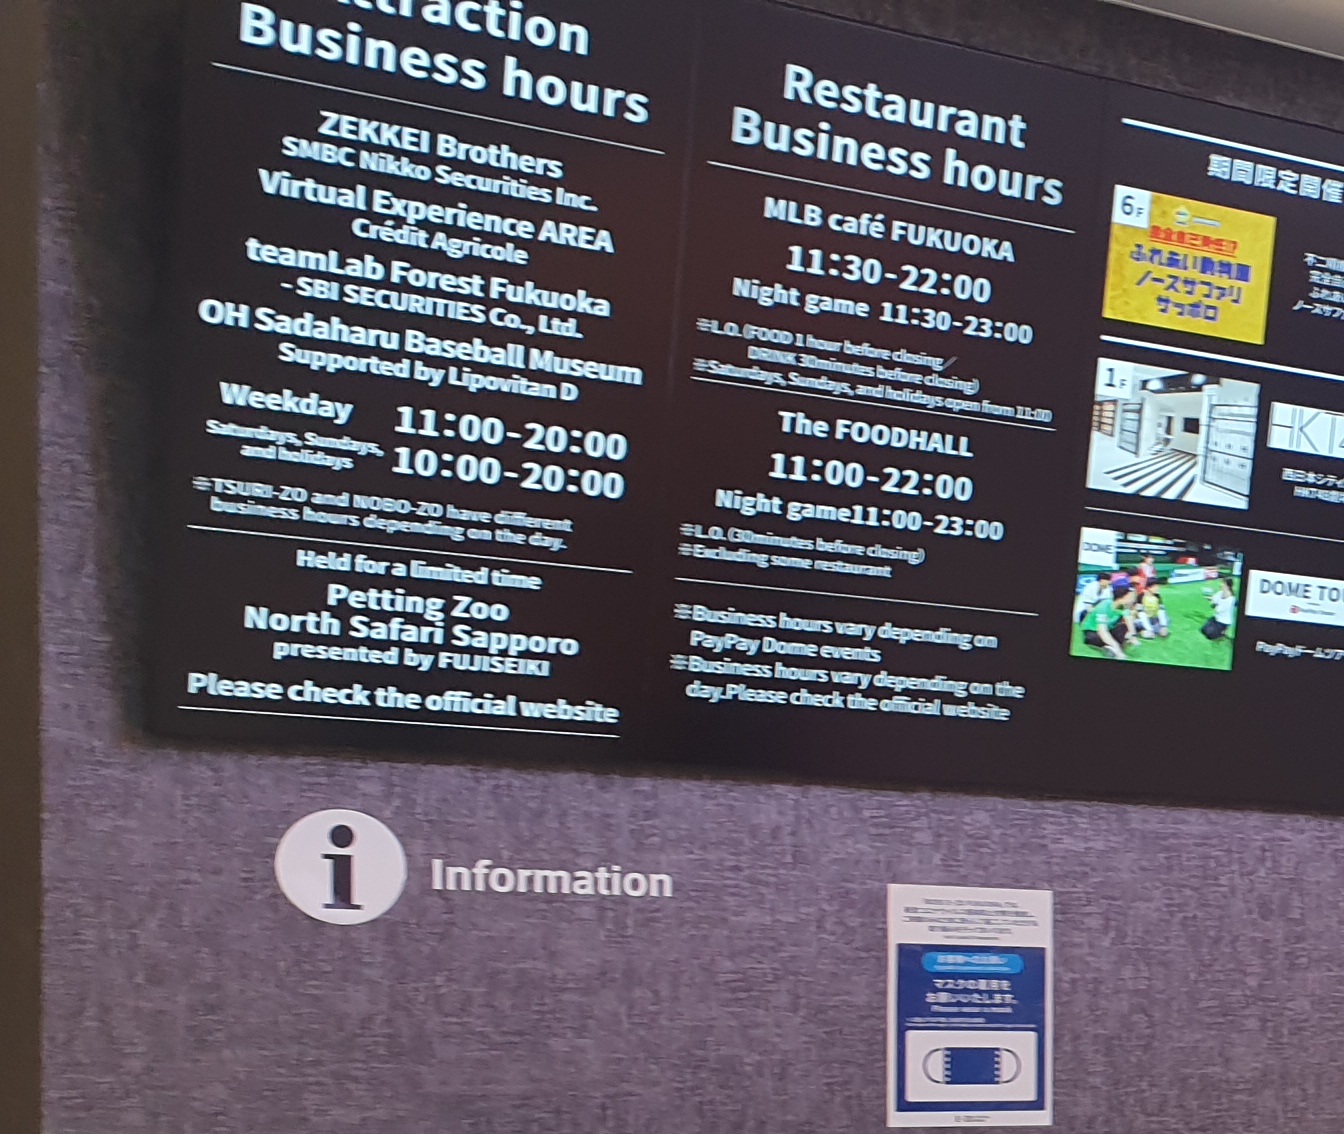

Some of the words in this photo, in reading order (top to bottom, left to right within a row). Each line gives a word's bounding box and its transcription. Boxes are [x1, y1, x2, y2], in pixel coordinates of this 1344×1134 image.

[337, 0, 589, 56] raction
[239, 2, 487, 91] Business
[502, 56, 650, 124] hours
[783, 63, 1026, 149] Restaurant
[318, 110, 429, 153] ZEKKEI
[437, 133, 563, 178] Brothers
[731, 105, 932, 180] Business
[943, 149, 1065, 206] hours
[281, 136, 354, 167] SMBC
[359, 153, 431, 180] Nikko
[435, 165, 552, 204] Securities
[556, 188, 599, 211] Inc.
[1207, 153, 1344, 204] 期間限定開催
[258, 169, 366, 211] Virtual
[373, 189, 533, 241] Experience
[539, 217, 614, 253] AREA
[763, 196, 823, 227] MLB
[828, 210, 885, 238] café
[890, 220, 1015, 263] FUKUOKA
[352, 218, 428, 251] Crédit
[431, 231, 528, 264] Agricole
[245, 238, 384, 281] teamLab
[392, 261, 483, 297] Forest
[490, 277, 611, 317] Fukuoka
[785, 245, 991, 303] 11:30-22:00
[296, 278, 338, 301] SBI
[343, 284, 485, 323] SECURITIES
[539, 315, 583, 339] Ltd.
[732, 277, 800, 307] Night
[805, 294, 870, 317] game
[879, 302, 1033, 344] 11:30-23:00
[199, 300, 250, 327] OH
[254, 306, 399, 349] Sadaharu
[406, 330, 525, 369] Baseball
[529, 348, 643, 385] Museum
[279, 343, 410, 380] Supported
[414, 361, 444, 387] by
[449, 367, 556, 400] Lipovitan
[560, 382, 579, 401] D
[206, 419, 302, 448] Saturdays,
[305, 430, 384, 457] Sundays,
[220, 381, 353, 424] Weekday
[394, 406, 628, 461] 11:00-20:00
[778, 411, 828, 437] The
[835, 419, 974, 458] FOODHALL
[240, 443, 275, 461] and
[278, 447, 354, 470] holidays
[392, 446, 625, 500] 10:00-20:00
[768, 453, 973, 501] 11:00-22:00
[210, 496, 299, 521] business
[303, 506, 359, 528] hours
[364, 513, 464, 541] depending
[468, 525, 492, 540] on
[496, 526, 525, 544] the
[529, 532, 567, 550] day.
[311, 490, 350, 507] and
[353, 495, 444, 520] NOBO-ZO
[447, 505, 491, 527] have
[494, 509, 573, 533] different
[715, 489, 783, 517] Night
[297, 550, 351, 573] Held
[355, 556, 387, 576] for
[391, 564, 407, 578] a
[410, 560, 487, 586] limited
[492, 568, 542, 590] time
[770, 554, 812, 570] some
[814, 559, 892, 578] restaurant
[1259, 578, 1311, 599] DOME
[327, 583, 444, 621] Petting
[451, 595, 509, 621] Zoo
[244, 606, 340, 636] North
[349, 615, 444, 644] Safari
[452, 624, 580, 657] Sapporo
[690, 630, 760, 656] PayPay
[762, 636, 817, 657] Dome
[820, 645, 881, 662] events
[779, 613, 832, 634] hours
[835, 621, 875, 641] vary
[878, 623, 971, 650] depending
[974, 634, 998, 648] on
[273, 641, 398, 666] presented
[404, 648, 434, 670] by
[439, 652, 551, 677] FUJISEIKI
[775, 662, 829, 683] hours
[831, 670, 871, 689] vary
[874, 670, 967, 697] depending
[970, 682, 992, 696] on
[995, 681, 1025, 698] the
[188, 673, 284, 699] Please
[288, 680, 370, 706] check
[376, 687, 421, 709] the
[425, 691, 516, 717] official
[520, 699, 619, 723] website
[790, 688, 845, 709] check
[847, 692, 878, 711] the
[880, 694, 941, 717] official
[943, 702, 1010, 721] website
[431, 859, 673, 897] Information
